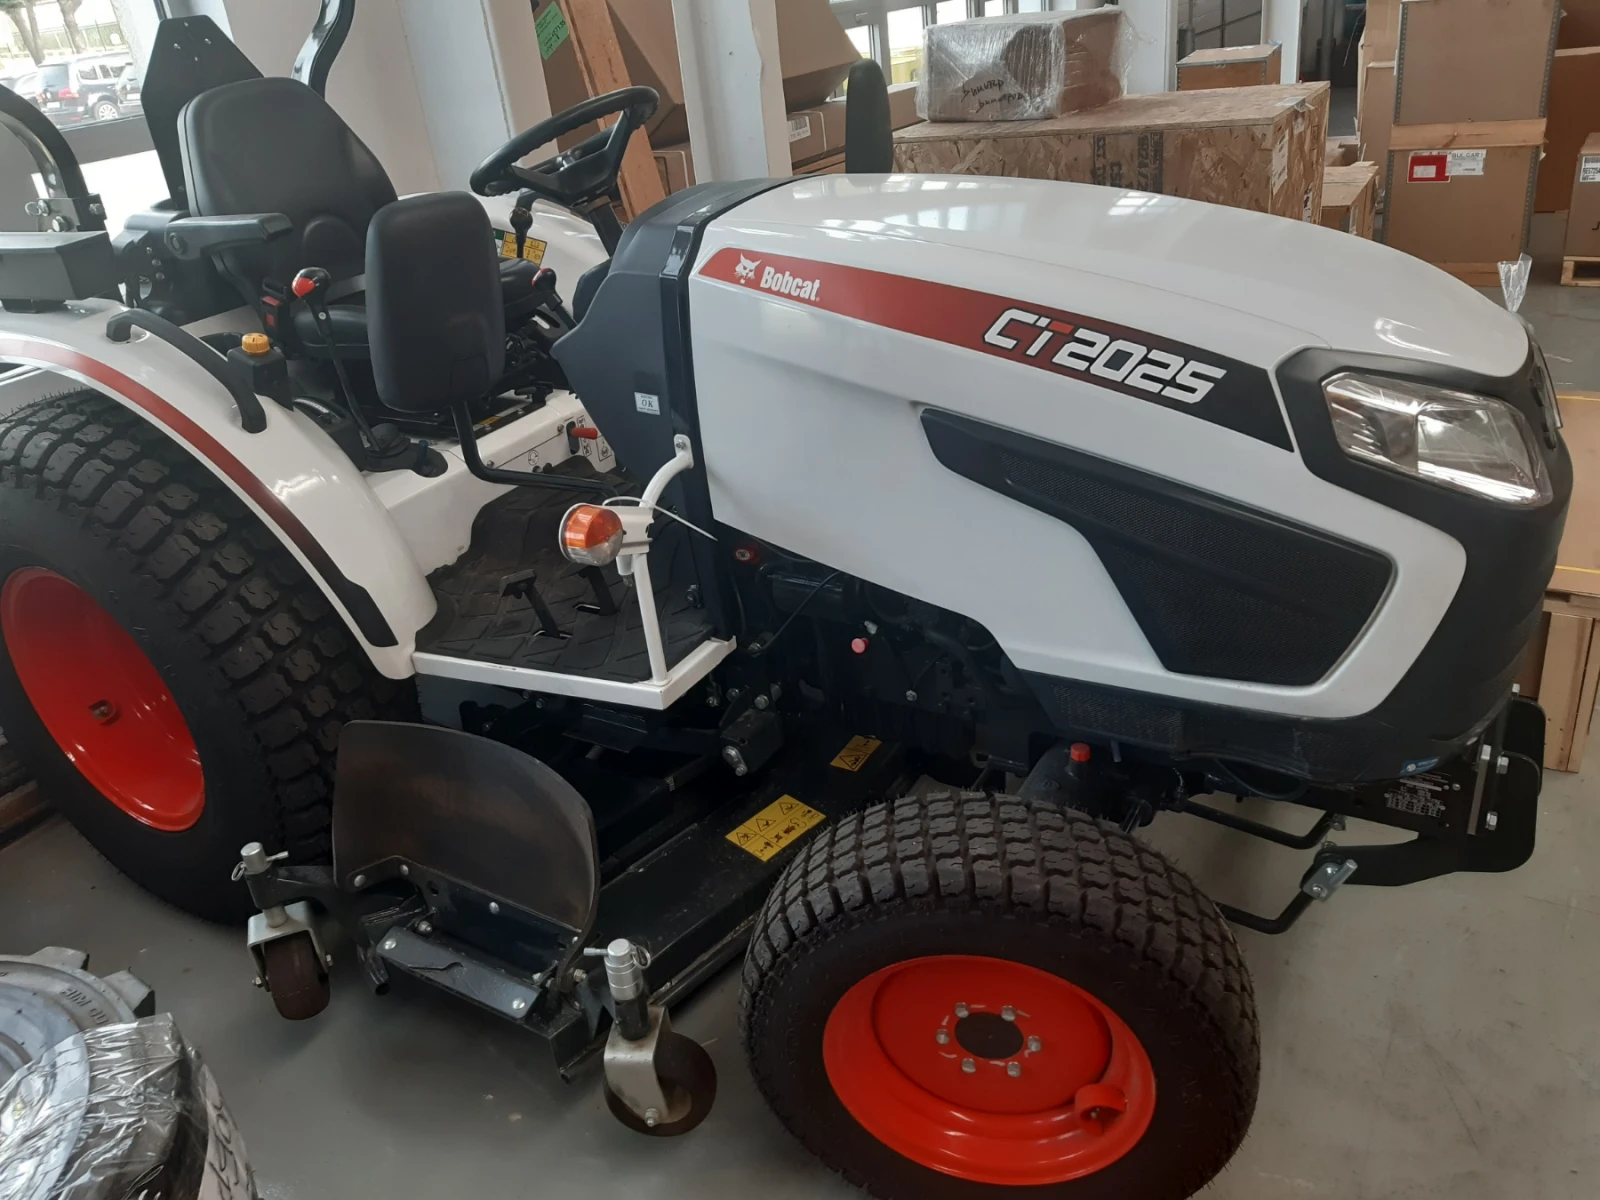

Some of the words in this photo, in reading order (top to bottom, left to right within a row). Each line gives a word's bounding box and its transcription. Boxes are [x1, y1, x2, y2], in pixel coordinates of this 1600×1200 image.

[759, 265, 820, 302] Bobcat
[983, 308, 1227, 404] CT2025
[641, 399, 654, 408] OK
